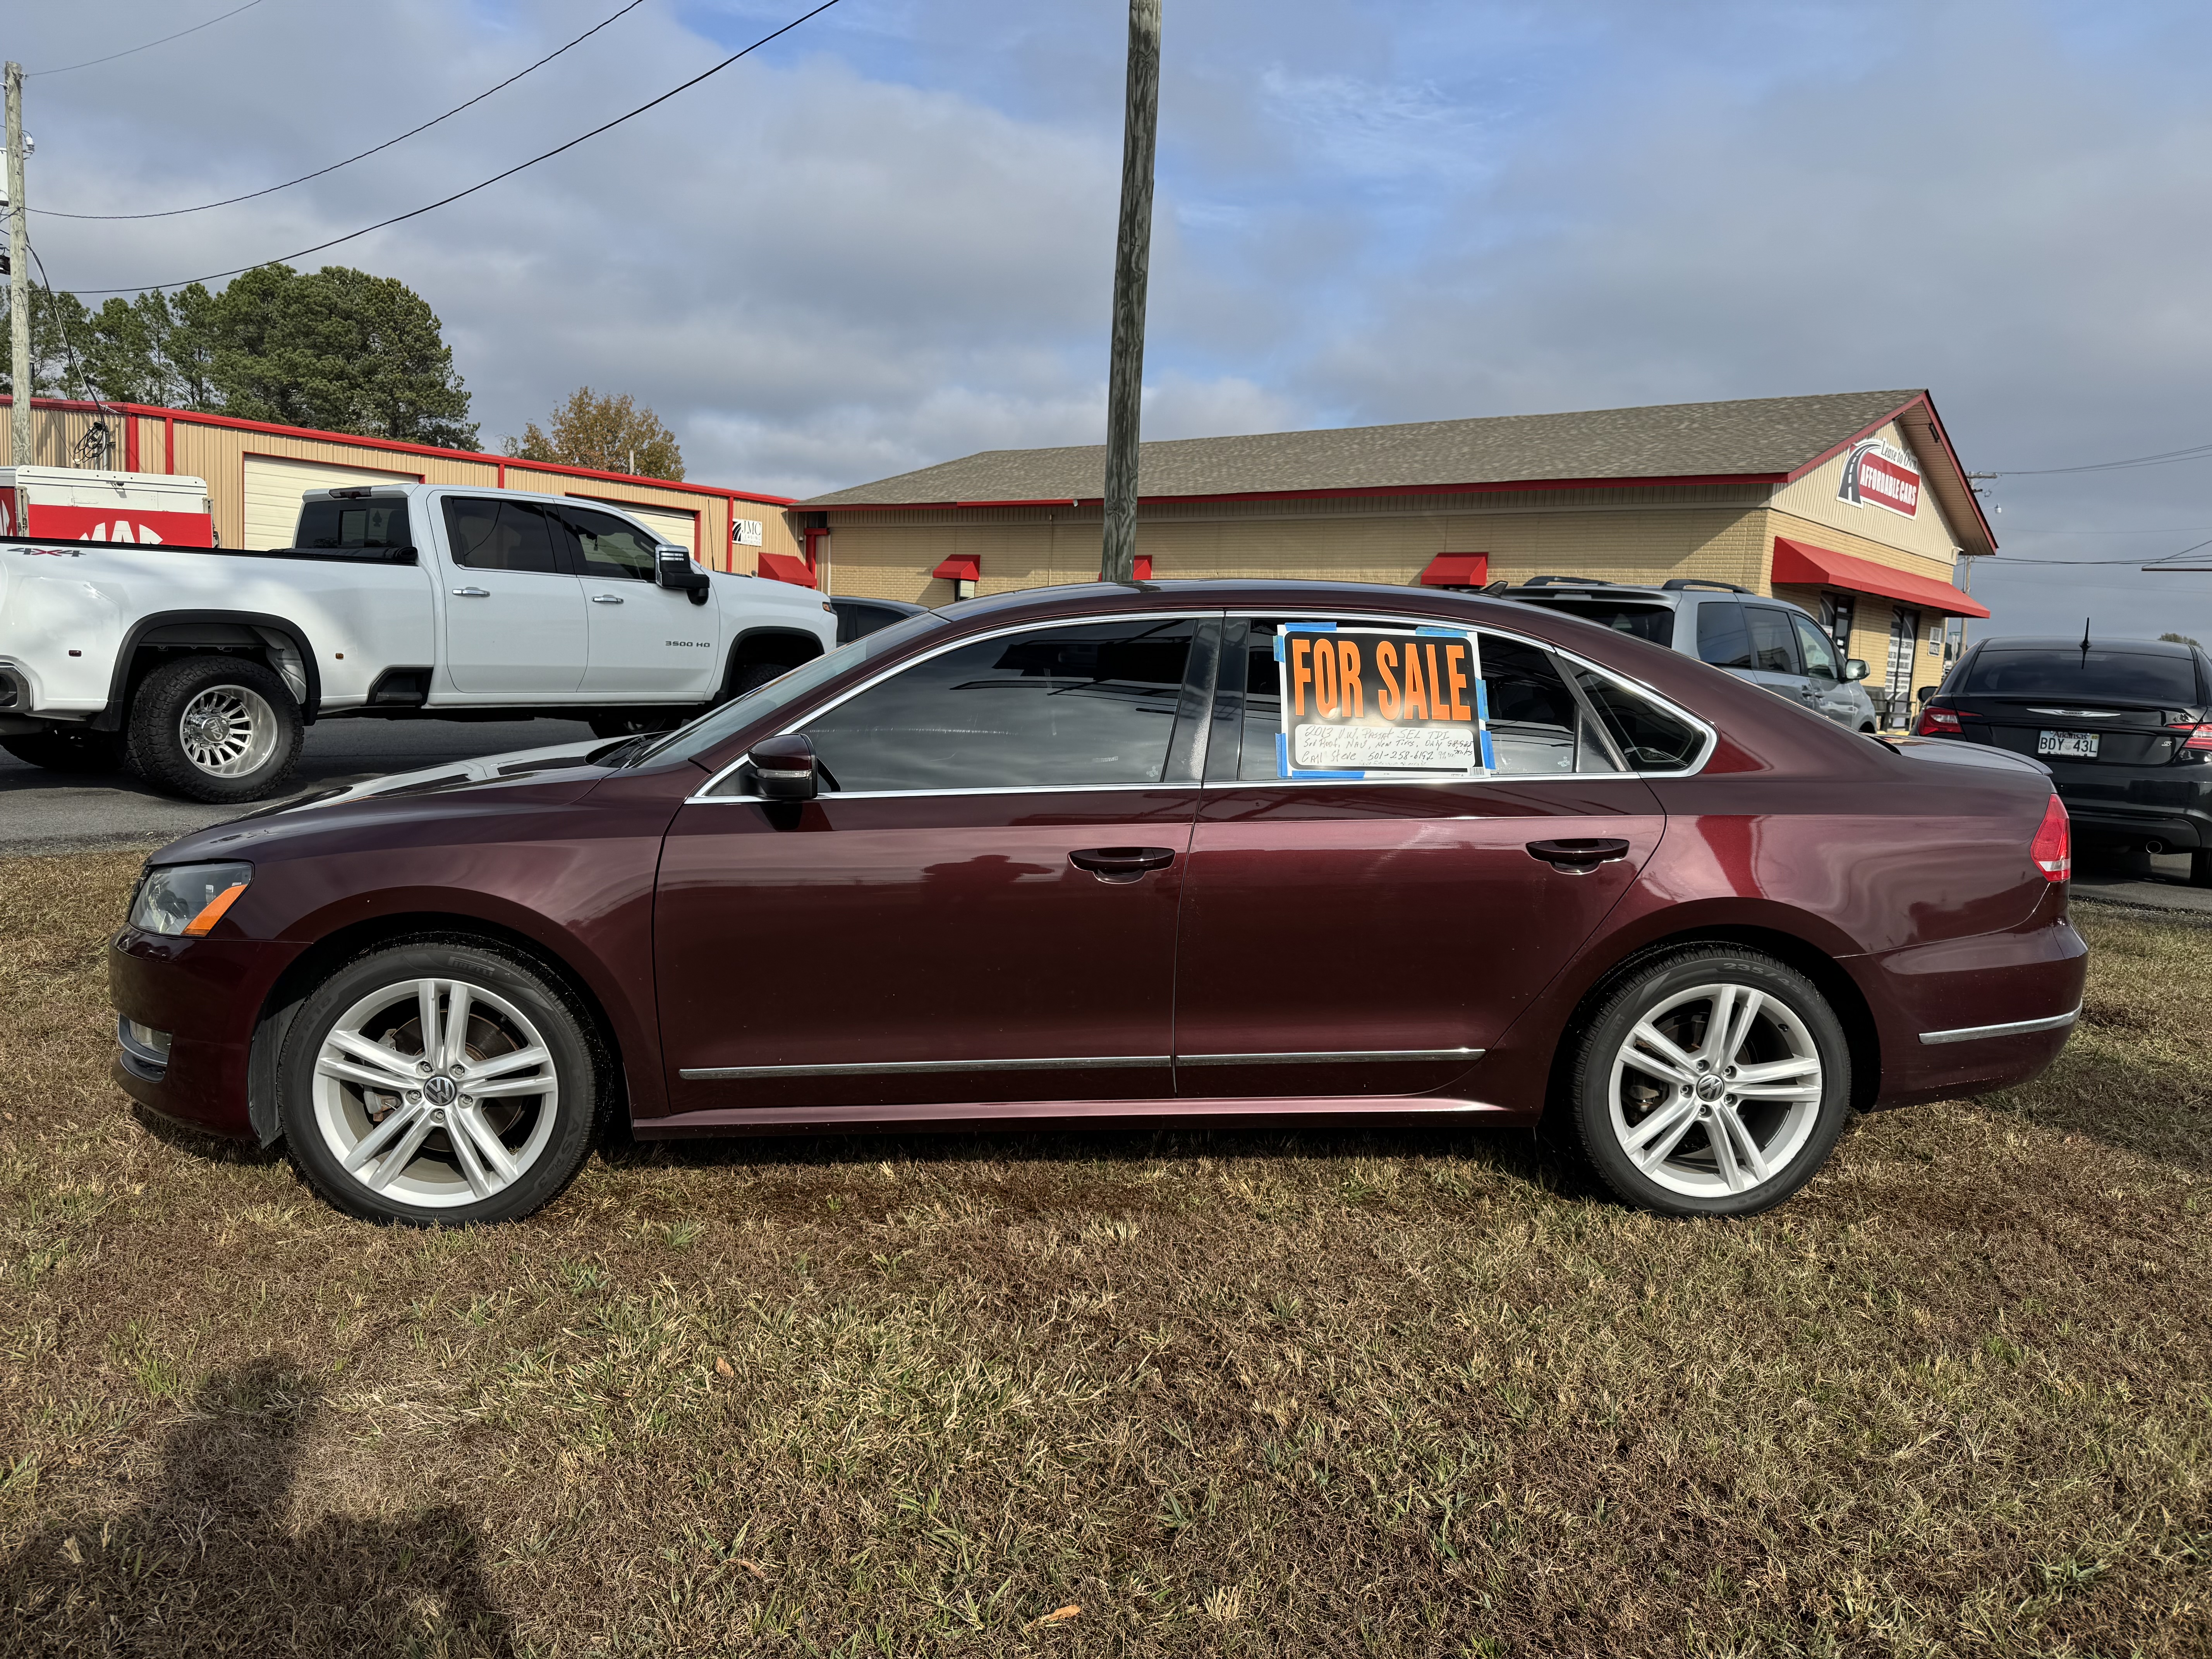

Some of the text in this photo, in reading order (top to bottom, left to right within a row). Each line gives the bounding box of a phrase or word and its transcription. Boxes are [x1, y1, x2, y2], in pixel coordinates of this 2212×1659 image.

[1881, 441, 1917, 470] Lease to Own
[1860, 464, 1917, 507] AFFORDABLE CARS
[742, 520, 761, 536] JMC
[1292, 639, 1471, 721] FOR SALE
[1305, 725, 1333, 738] 2013
[1397, 728, 1420, 739] SEL
[1428, 731, 1449, 740] TDI
[2053, 731, 2088, 739] Arkansas
[2040, 737, 2097, 753] BDY 43L
[1330, 749, 1356, 762] Steve
[1367, 750, 1434, 761] 501-258-6192
[1724, 963, 1801, 994] 235/45
